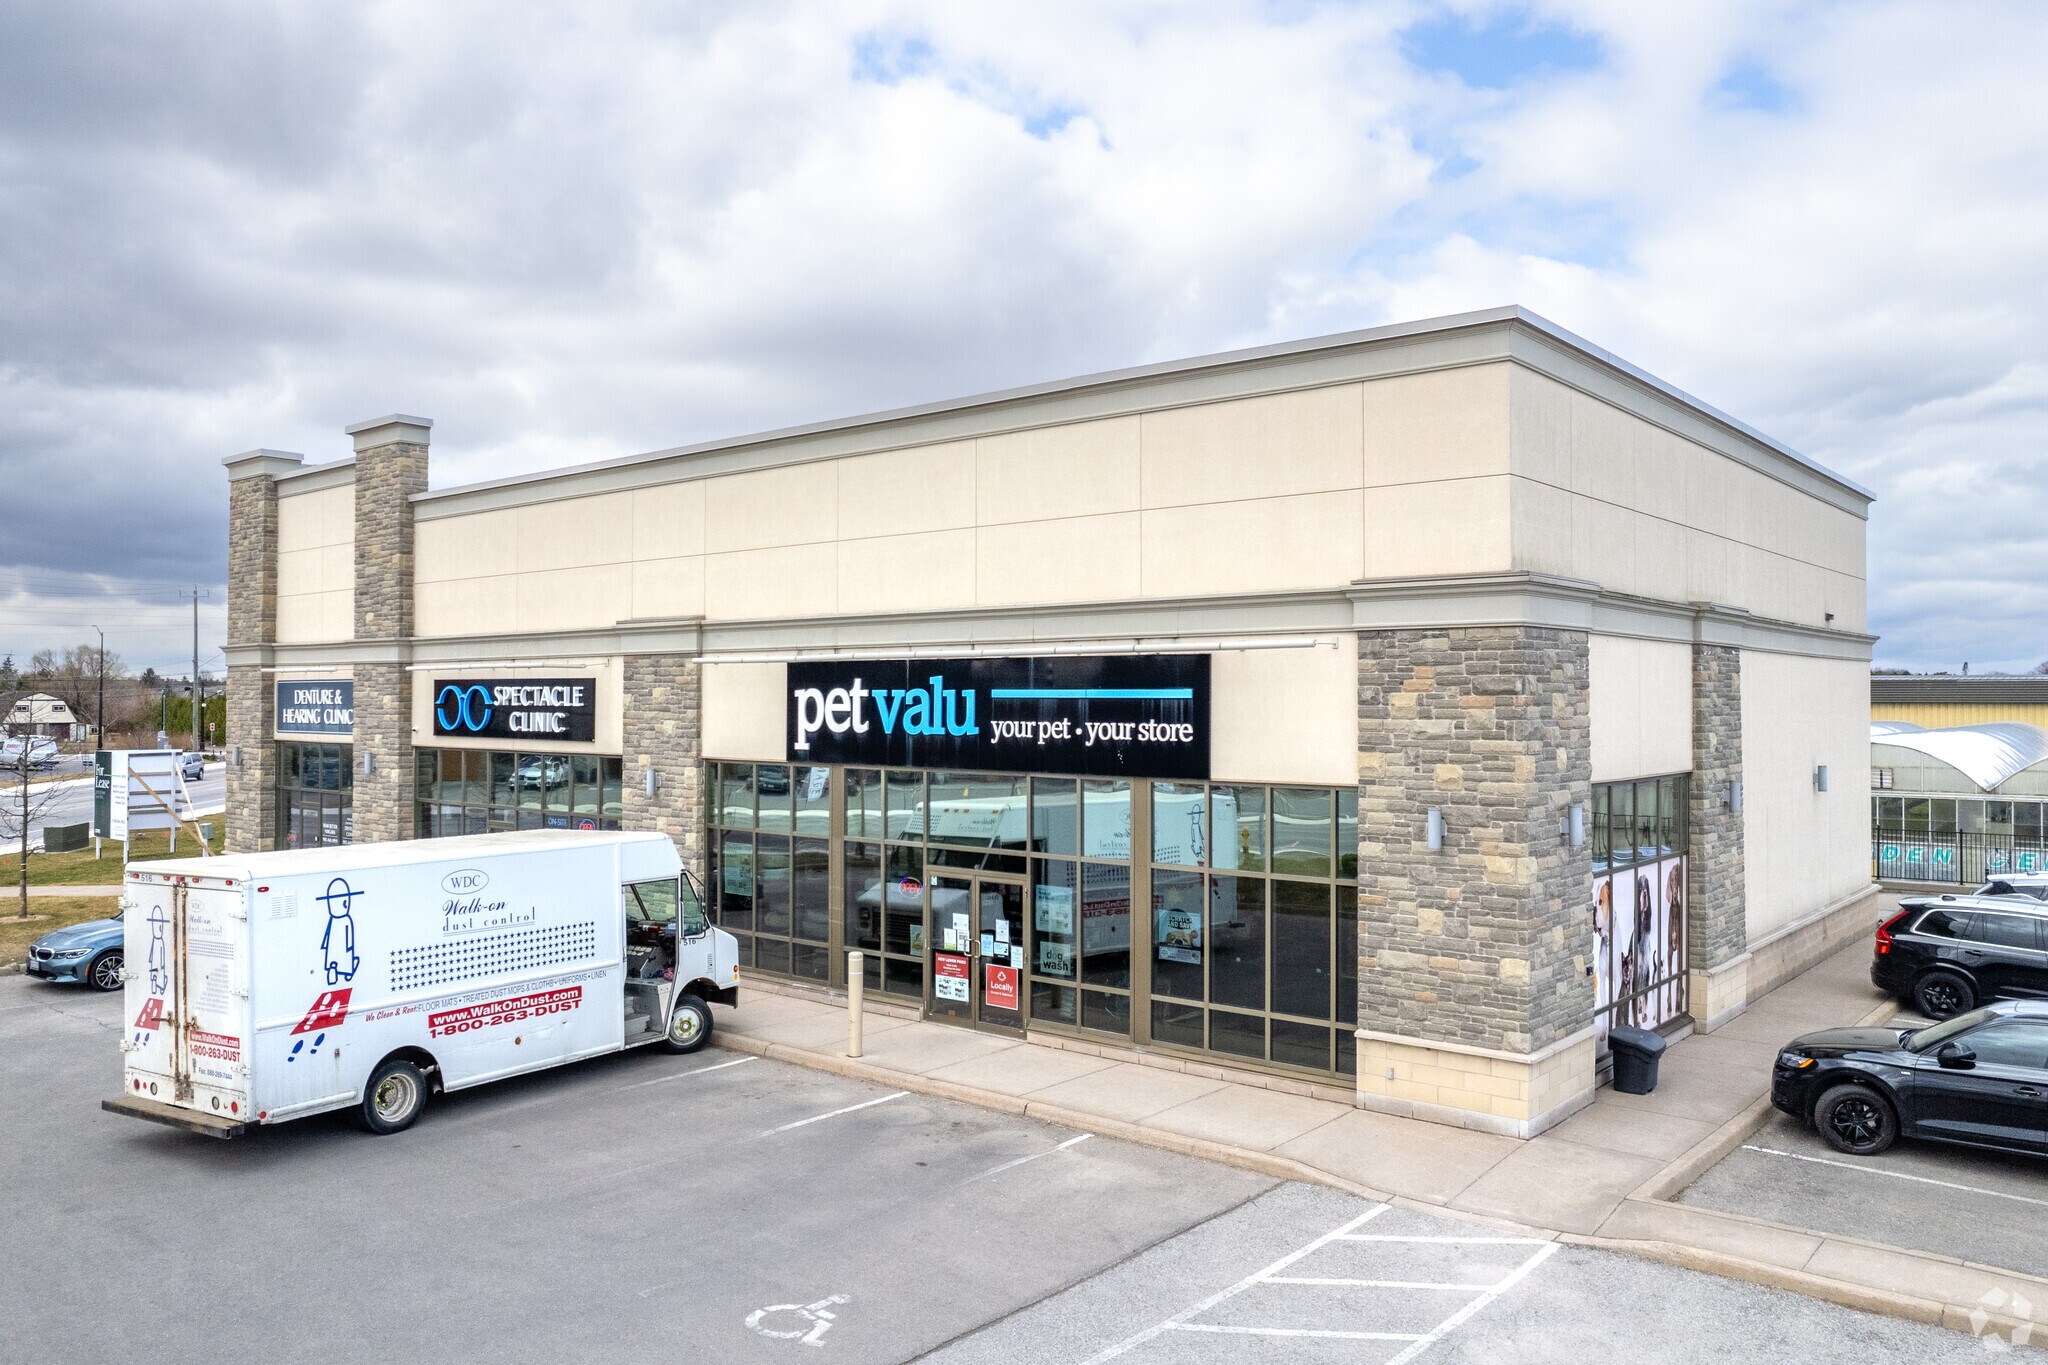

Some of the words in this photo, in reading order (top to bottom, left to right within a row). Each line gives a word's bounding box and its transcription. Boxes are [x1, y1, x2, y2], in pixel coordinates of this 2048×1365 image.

[294, 689, 333, 704] DENTURE
[334, 689, 342, 704] &
[494, 686, 584, 706] SPECTACLE
[283, 708, 320, 724] HEARING
[323, 709, 353, 725] CLINIC
[509, 711, 567, 732] CLINIC
[794, 678, 869, 750] pet
[872, 675, 979, 736] valu
[990, 718, 1036, 744] your
[1038, 717, 1071, 744] pet
[1086, 720, 1135, 746] your
[1137, 718, 1193, 742] store
[96, 776, 109, 788] Lease
[1872, 844, 1953, 864] DEN
[1986, 850, 2048, 869] CE
[141, 874, 152, 882] 516
[451, 875, 480, 889] WDC
[442, 898, 508, 917] Walk-on
[443, 917, 473, 932] dust
[484, 906, 535, 926] control
[1043, 961, 1068, 971] wash
[365, 1013, 375, 1021] We
[376, 1010, 394, 1019] Clean
[418, 1001, 441, 1012] FLOOR
[442, 997, 458, 1007] MATS
[462, 991, 490, 1003] TREATED
[490, 988, 507, 998] DUST
[531, 980, 554, 991] CLOTHS
[591, 970, 607, 979] LINEN
[990, 981, 1013, 993] Locally
[433, 989, 578, 1025] www.WalkOnDust.com
[430, 1000, 582, 1038] 1-800-263-DUST
[190, 1044, 241, 1062] 1-800-263-DUST
